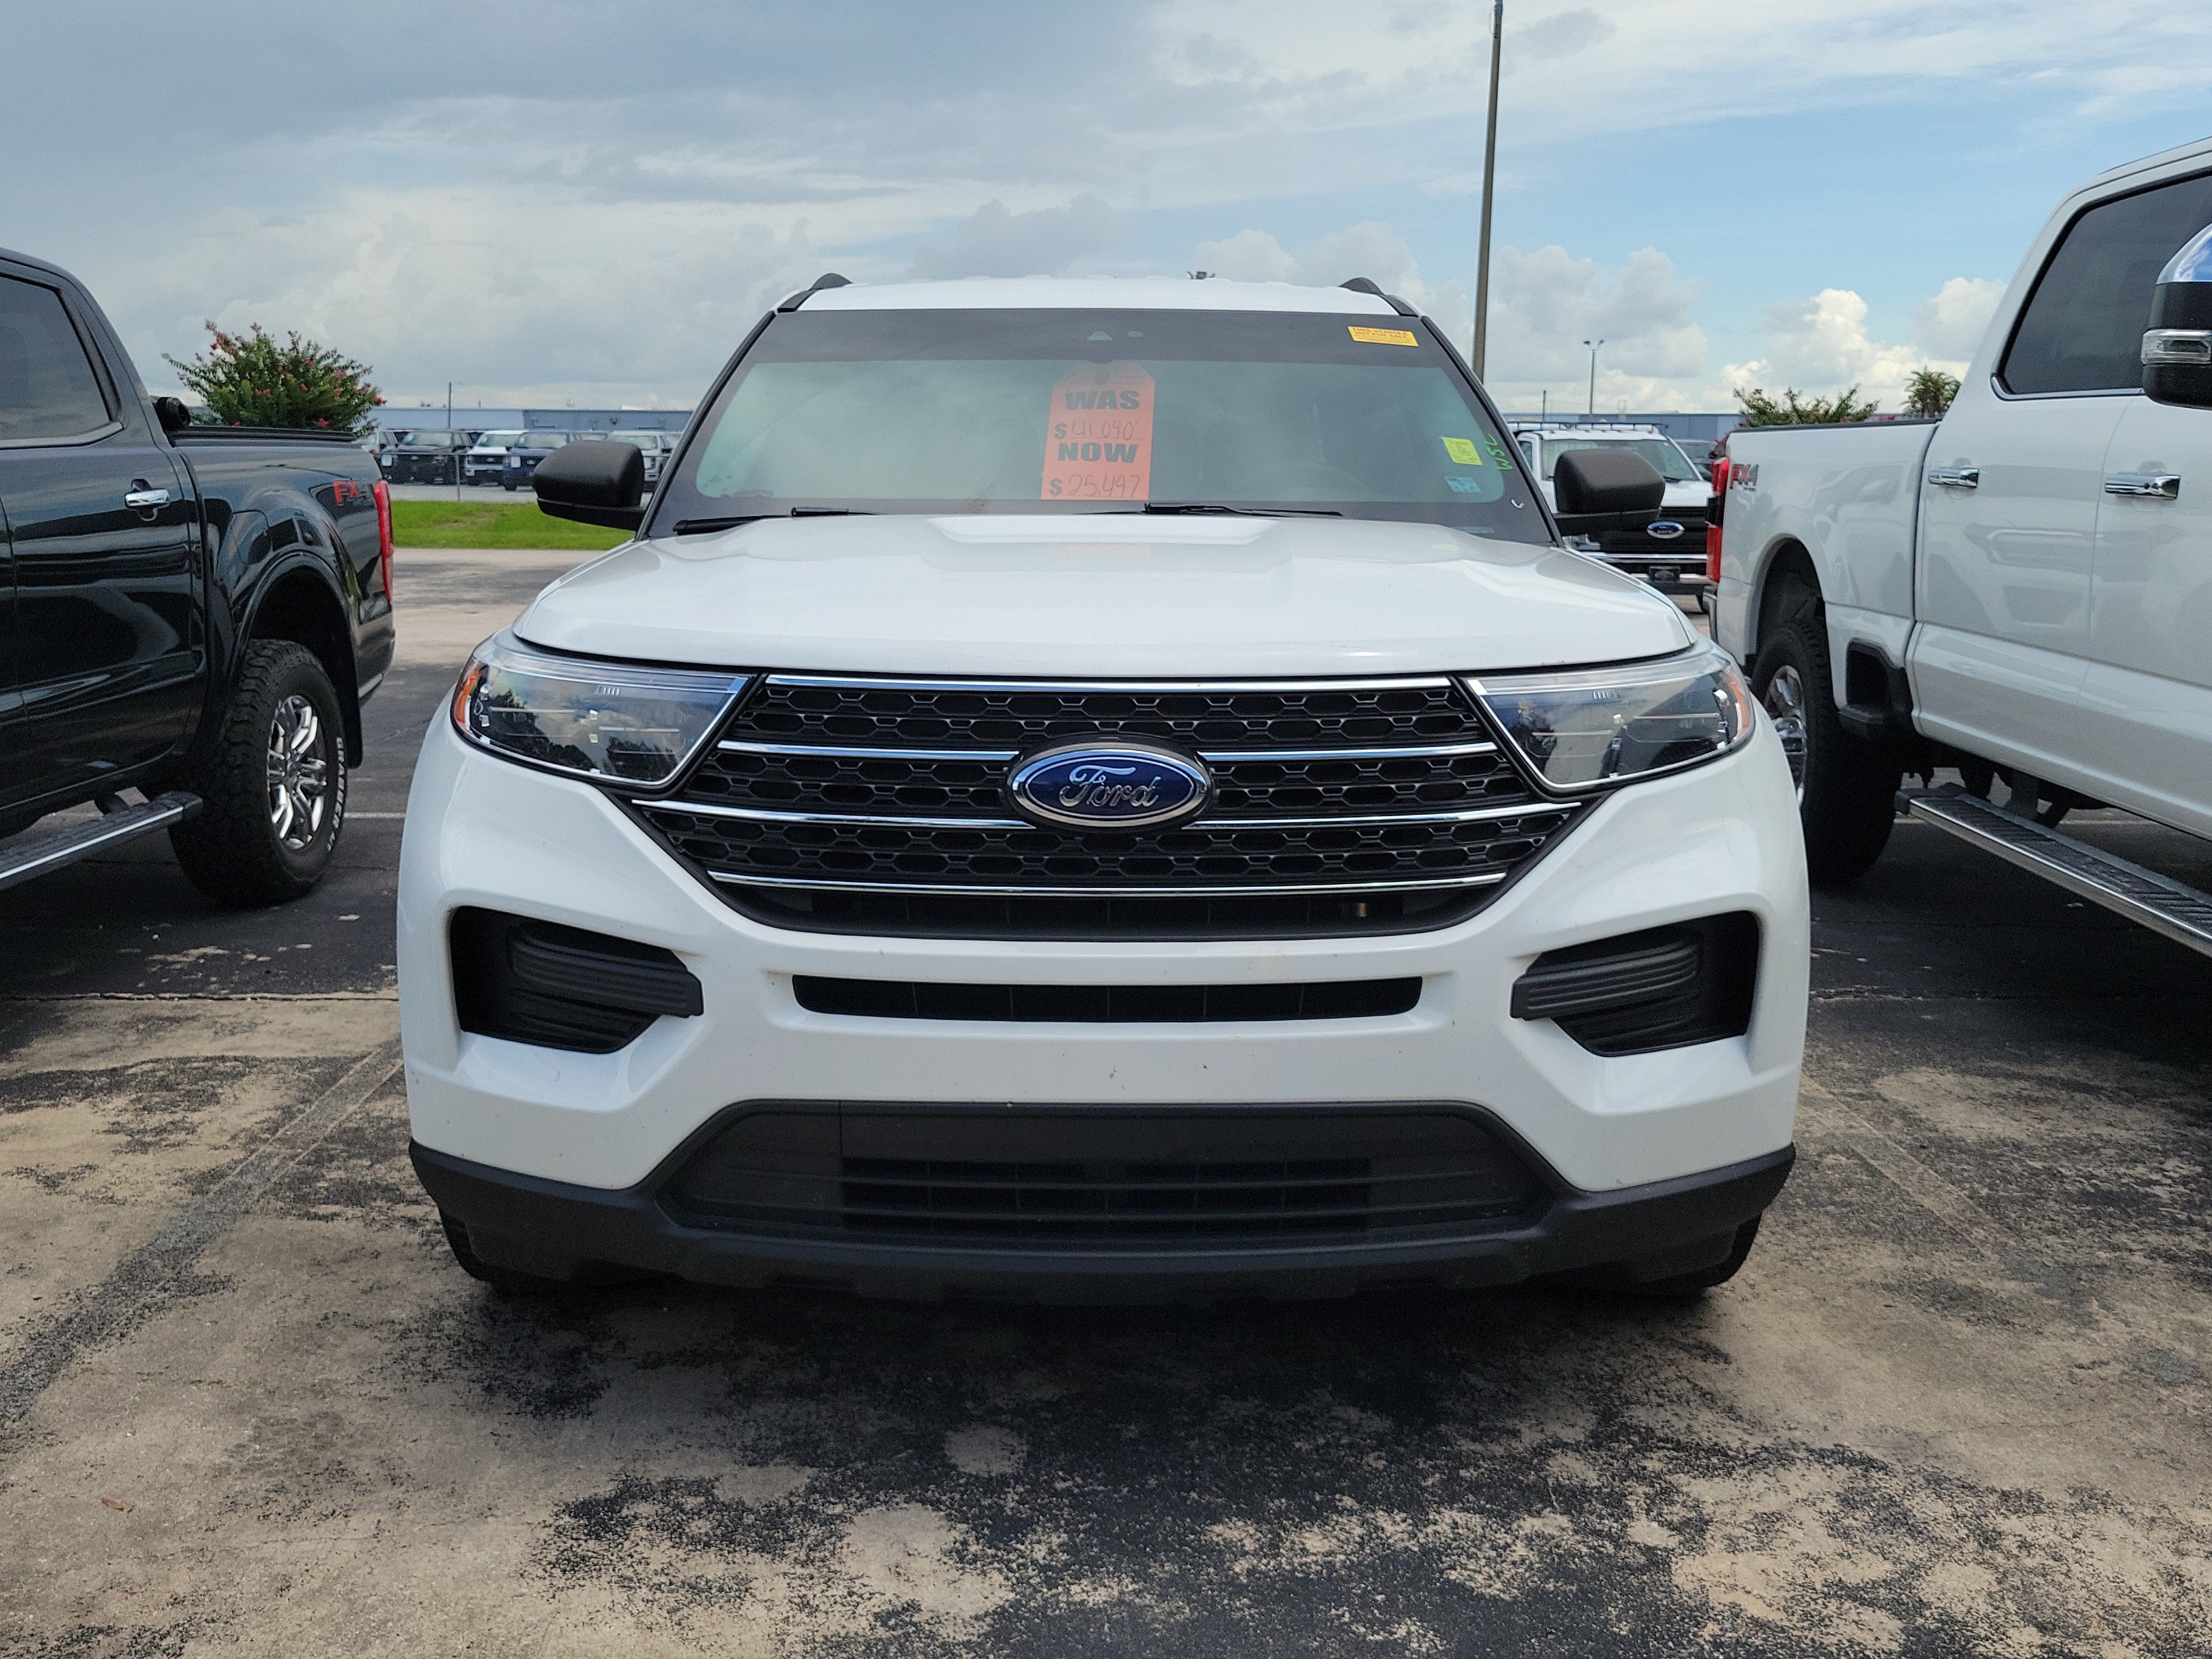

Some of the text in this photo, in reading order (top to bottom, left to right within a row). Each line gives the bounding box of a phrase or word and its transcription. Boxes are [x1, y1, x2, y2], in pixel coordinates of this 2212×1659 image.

[1065, 390, 1141, 410] WAS
[1058, 442, 1139, 463] NOW
[1059, 764, 1162, 808] Ford
